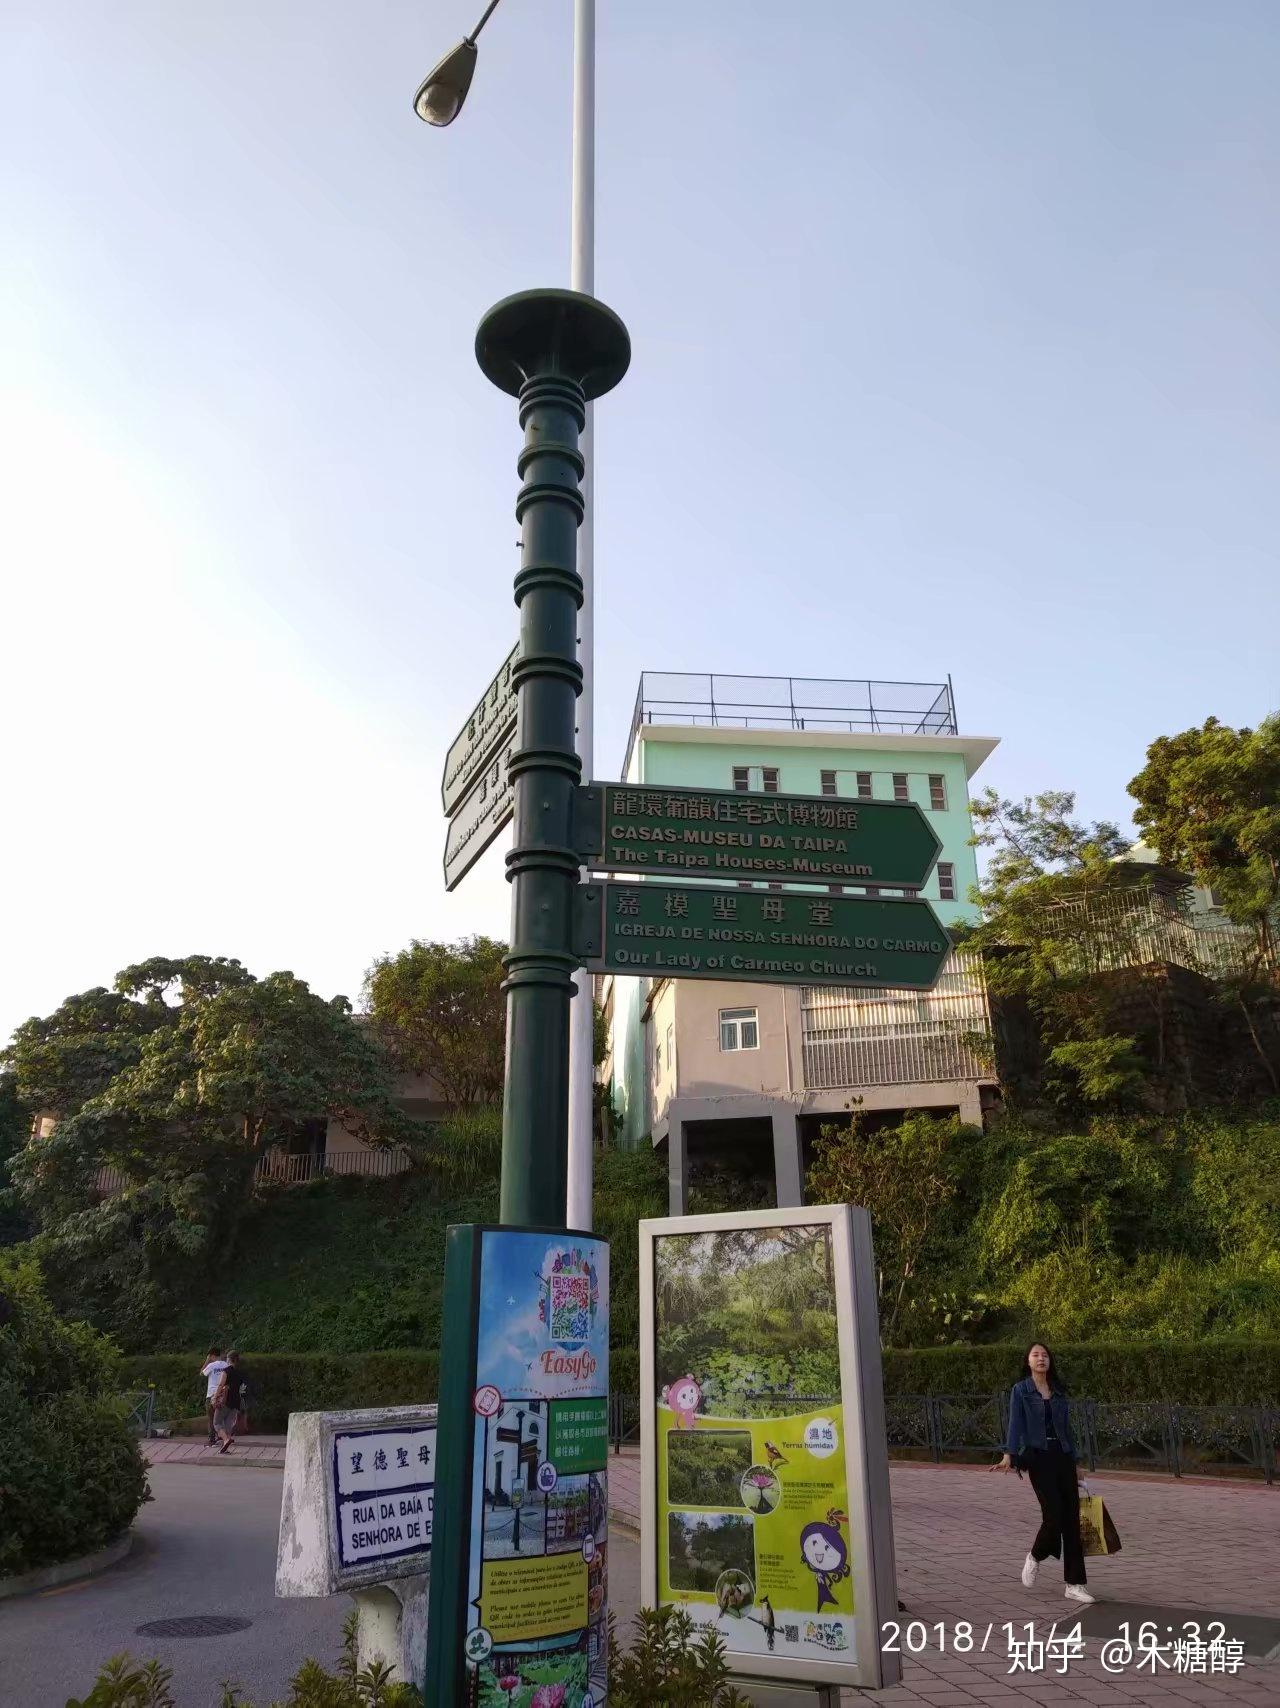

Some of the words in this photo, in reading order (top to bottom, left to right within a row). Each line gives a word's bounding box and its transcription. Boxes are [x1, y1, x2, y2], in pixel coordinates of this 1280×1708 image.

[612, 791, 858, 830] 龍環葡韻住宅式博物館
[611, 825, 753, 847] CASAS-MUSEU
[760, 834, 786, 849] DA
[791, 836, 848, 853] TAIPA
[612, 846, 649, 862] The
[655, 849, 709, 868] Taipa
[715, 852, 873, 876] Houses-Museum
[615, 889, 834, 927] 嘉模聖母堂
[614, 922, 677, 938] IGREJA
[681, 927, 703, 940] DE
[708, 928, 766, 944] NOSSA
[770, 931, 850, 949] SENHORA
[854, 936, 880, 950] DO
[883, 938, 943, 954] CARMO
[614, 949, 650, 965] Our
[655, 950, 701, 971] Lady
[706, 953, 726, 968] of
[809, 958, 877, 977] Church
[540, 1350, 597, 1381] EasyGo
[350, 1445, 431, 1475] 望德聖母
[352, 1507, 376, 1525] RUA
[380, 1504, 395, 1520] DA
[400, 1496, 424, 1517] BAÍA
[351, 1524, 403, 1550] SENHORA
[407, 1521, 421, 1540] DE
